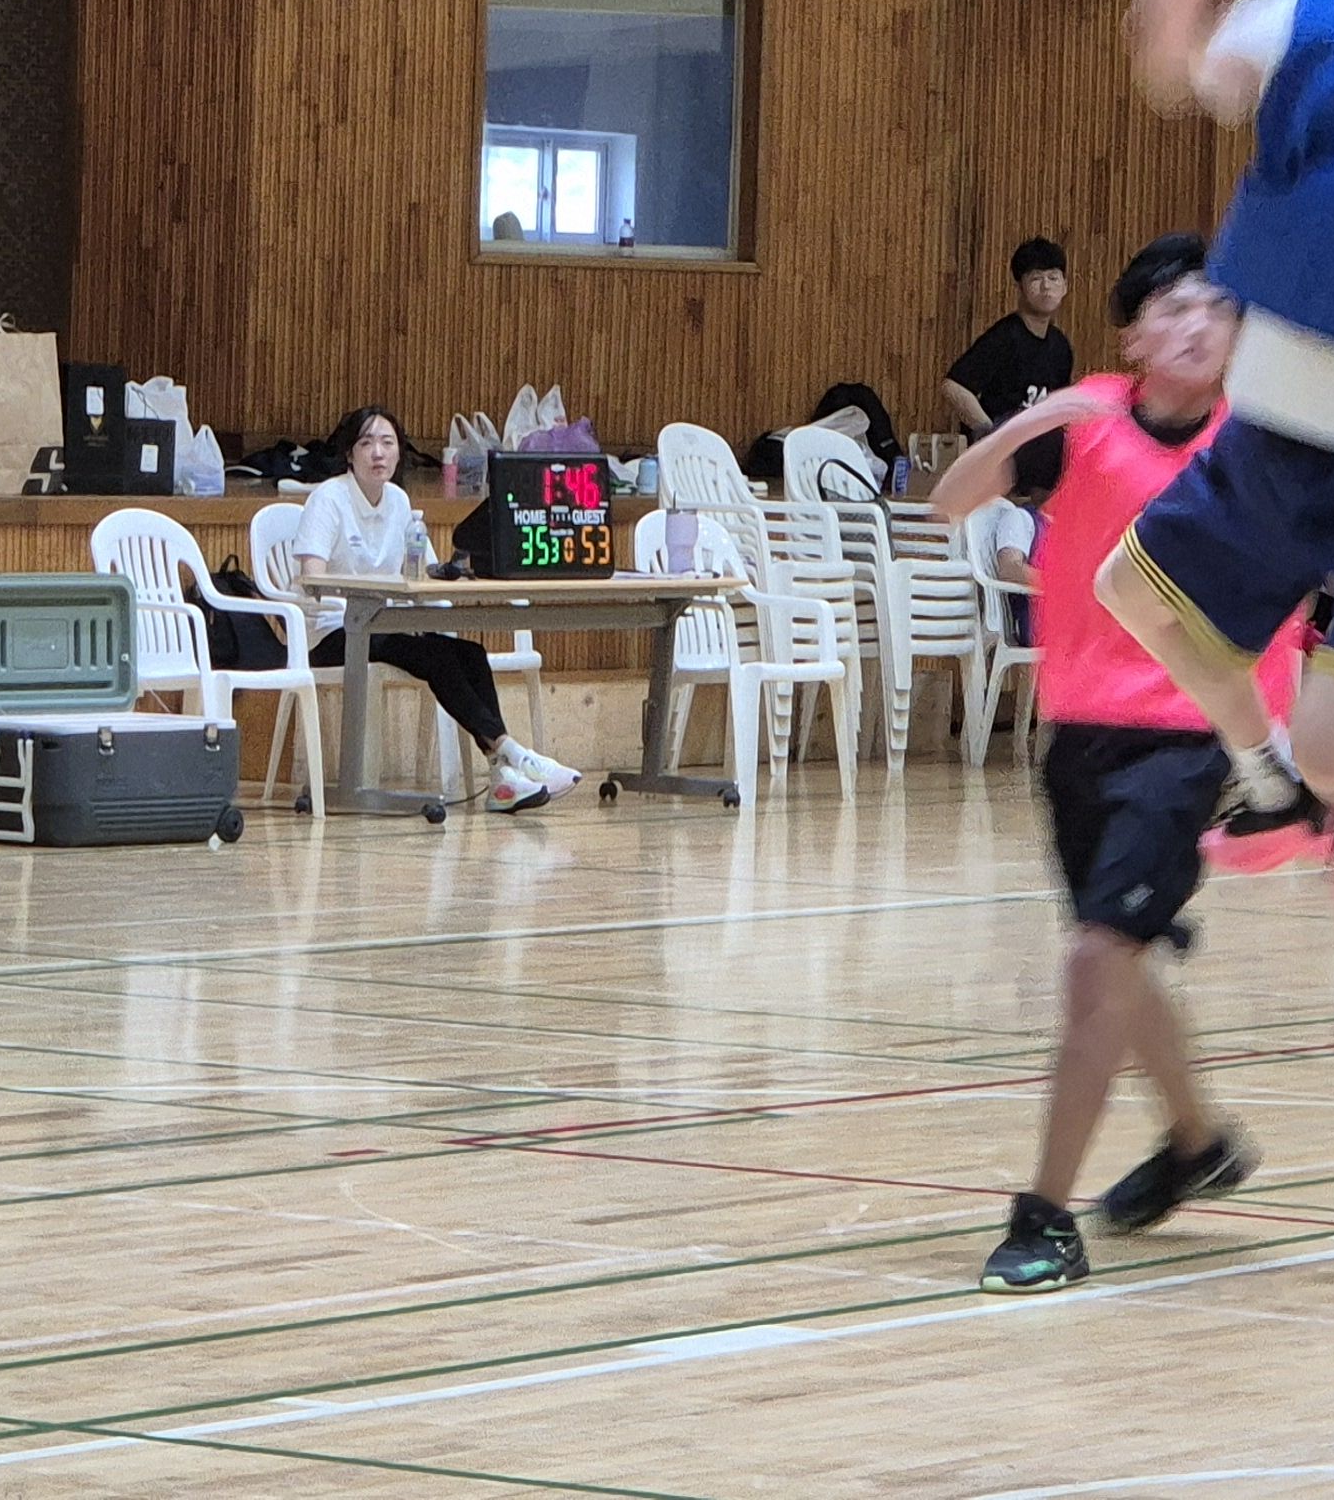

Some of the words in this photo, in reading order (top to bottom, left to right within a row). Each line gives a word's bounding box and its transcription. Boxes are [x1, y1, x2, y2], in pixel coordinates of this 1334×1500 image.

[543, 463, 602, 510] 1:46
[514, 509, 547, 526] HOME
[571, 509, 606, 526] GUEST
[521, 525, 550, 566] 35
[581, 525, 611, 566] 53
